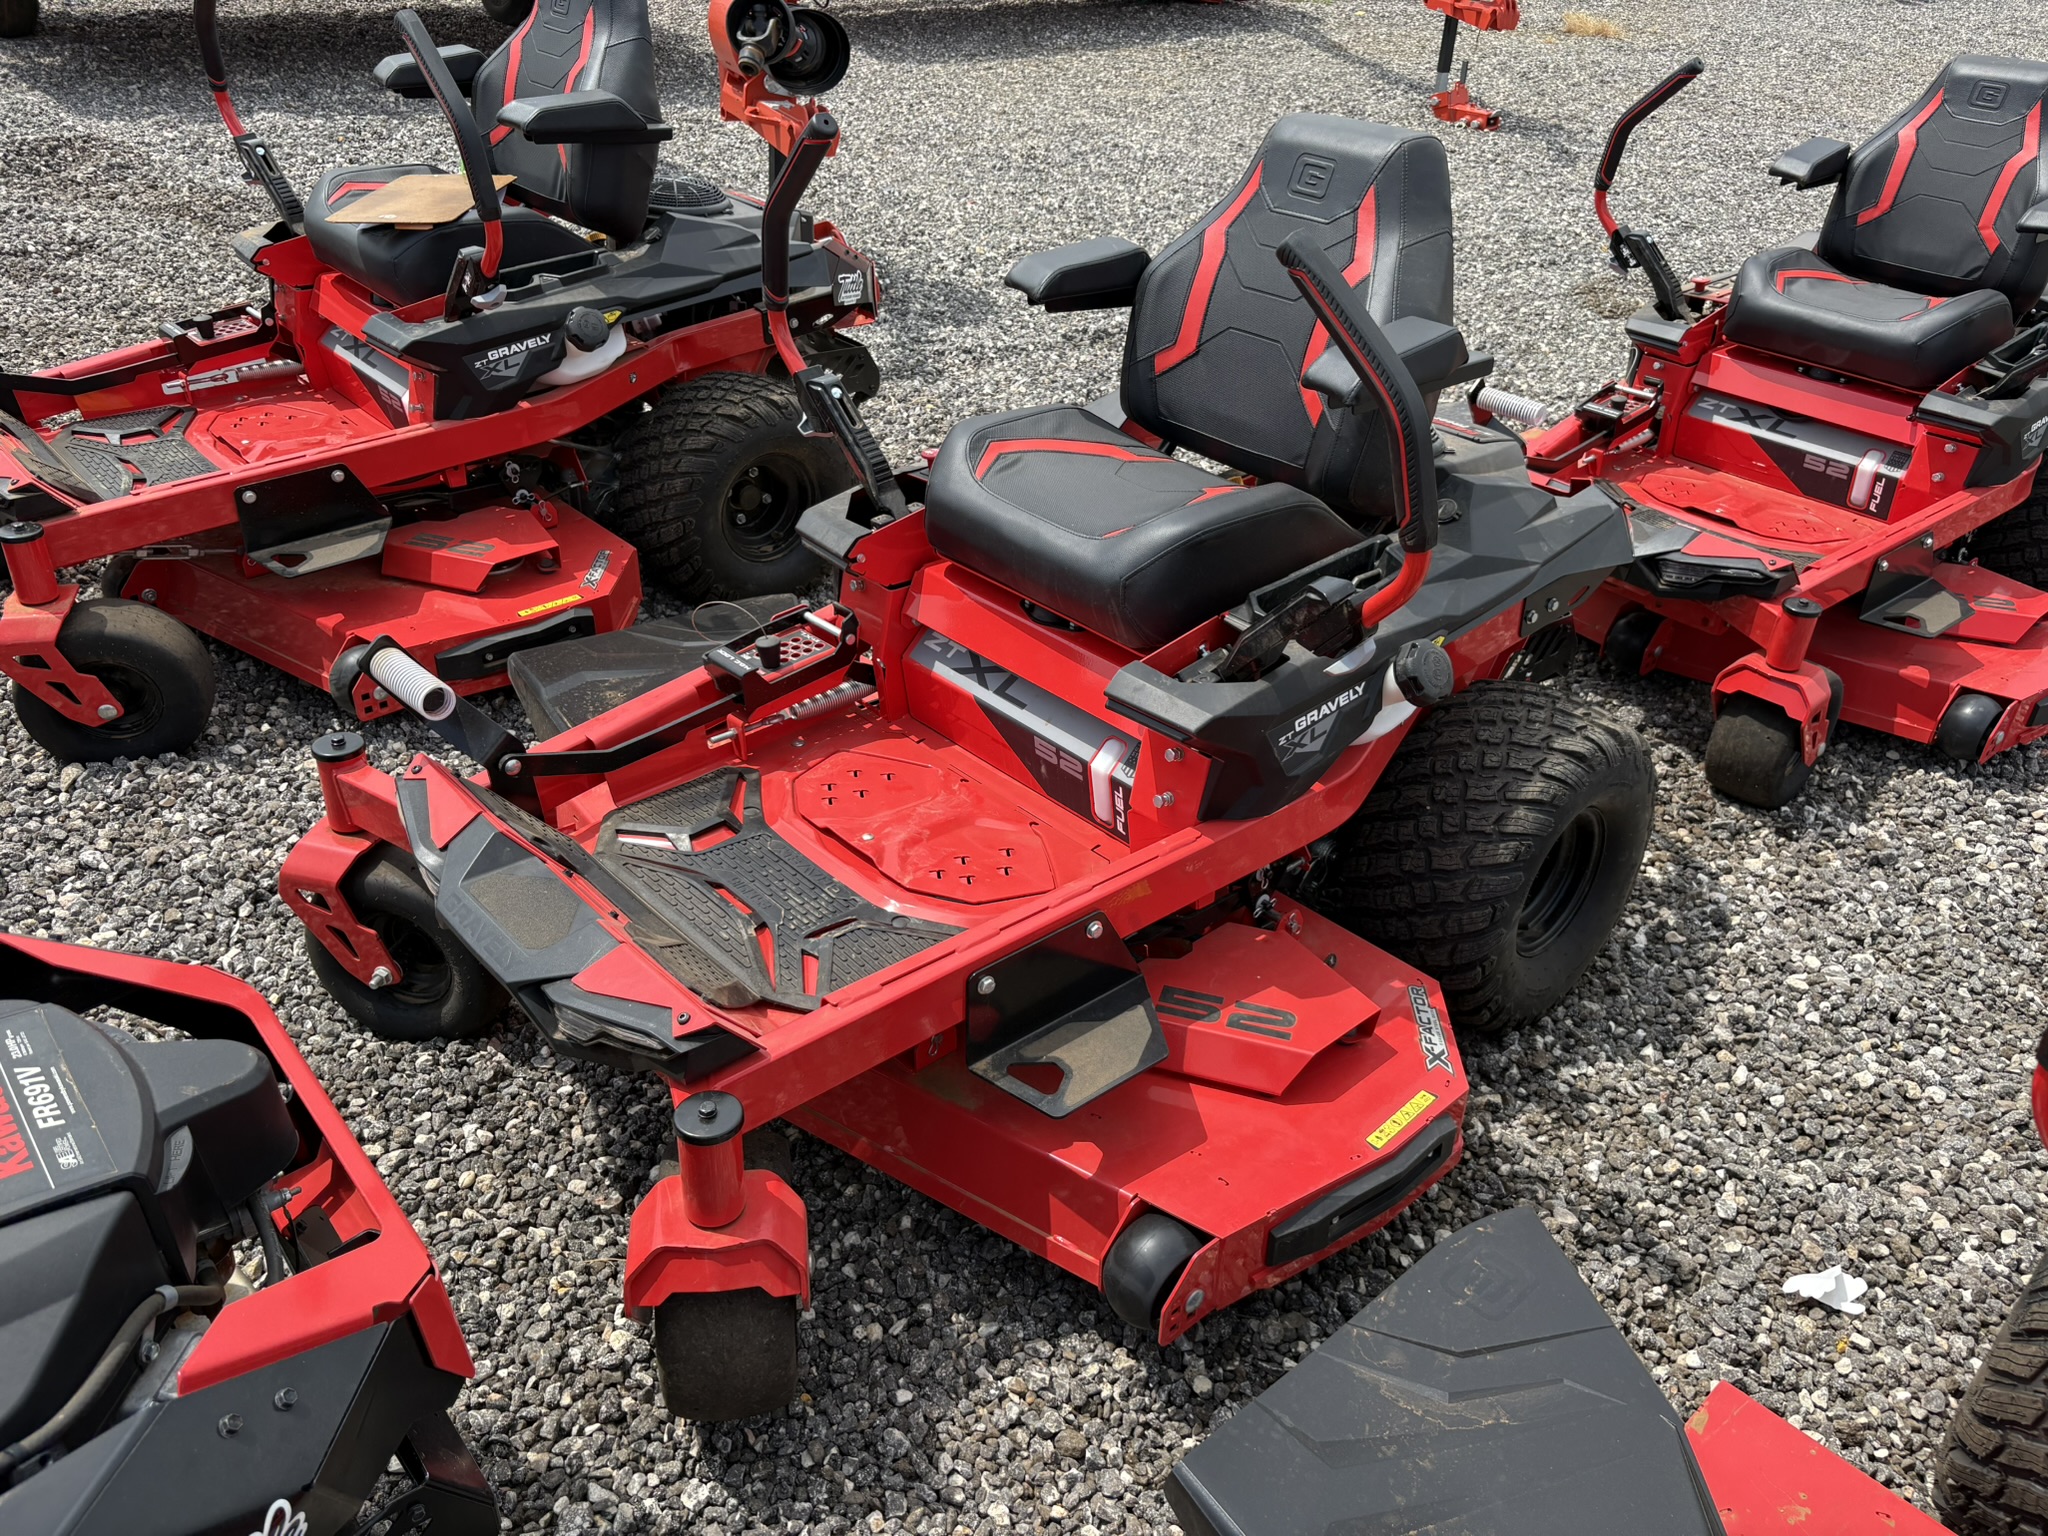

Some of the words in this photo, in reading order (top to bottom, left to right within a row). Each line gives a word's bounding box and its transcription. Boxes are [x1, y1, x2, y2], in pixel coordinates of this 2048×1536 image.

[342, 335, 377, 369] XL
[474, 358, 489, 368] ZT
[487, 333, 551, 361] GRAVELY
[480, 358, 520, 381] XL
[378, 385, 403, 413] 52
[1697, 396, 1737, 412] ZT
[1731, 406, 1796, 439] XL
[1803, 454, 1849, 480] 52
[1869, 477, 1886, 513] FUEL
[405, 533, 496, 558] 52
[924, 632, 967, 658] ZT
[951, 650, 1028, 710] XL
[1294, 681, 1366, 732] GRAVELY
[1278, 731, 1295, 746] ZT
[1281, 726, 1327, 762] XL
[1034, 735, 1083, 781] 52
[1114, 786, 1126, 835] FUEL
[1155, 984, 1297, 1041] 52
[1410, 985, 1453, 1074] X-FACTOR
[13, 1066, 66, 1129] FR691V
[170, 1139, 185, 1161] HERE
